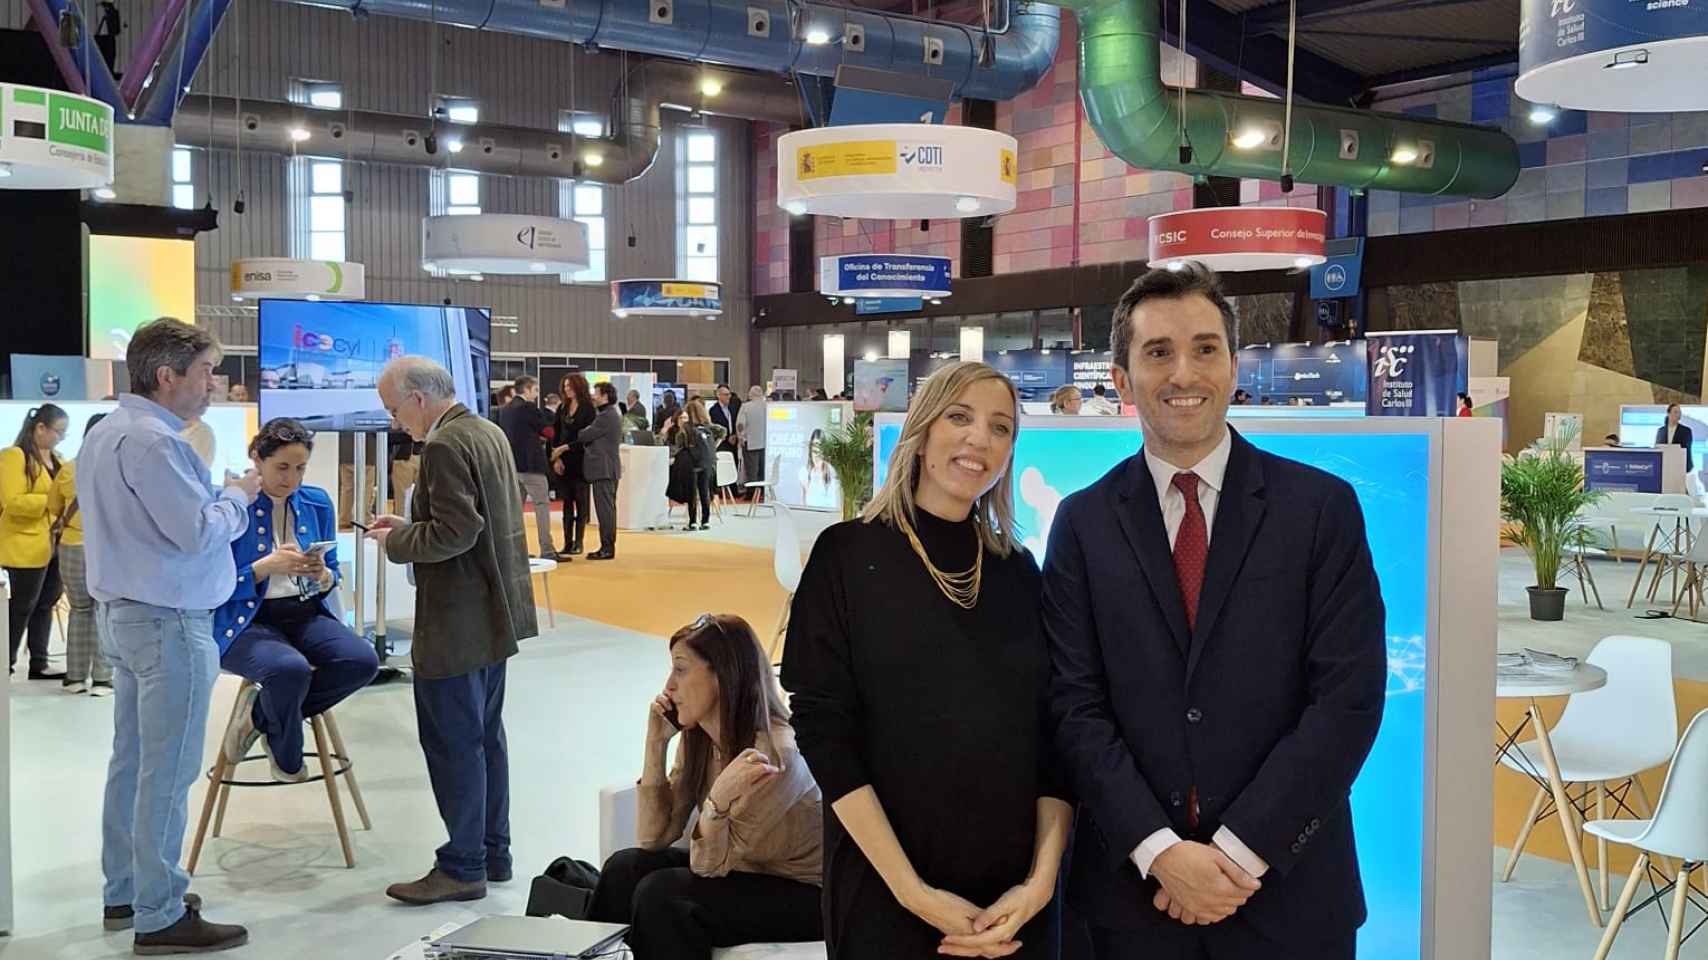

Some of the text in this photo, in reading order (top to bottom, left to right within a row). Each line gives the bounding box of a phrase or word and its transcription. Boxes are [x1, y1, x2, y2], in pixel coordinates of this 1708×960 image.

[1646, 0, 1689, 10] science
[1558, 13, 1585, 26] Instituto
[1557, 21, 1585, 37] de Salud
[1557, 34, 1577, 47] Carlos
[59, 107, 99, 136] JUNTA
[918, 146, 942, 165] CDTI
[1158, 230, 1187, 244] CSIC
[1210, 228, 1253, 241] Consejo
[1255, 227, 1295, 242] Superior
[1296, 228, 1306, 239] de
[844, 263, 870, 271] Oficina
[884, 262, 935, 272] Transferencia
[244, 271, 271, 281] enisa
[856, 272, 926, 281] del Conocimiento
[1383, 380, 1413, 388] Instituto
[1382, 389, 1413, 398] de Salud
[1381, 398, 1405, 407] Carlos
